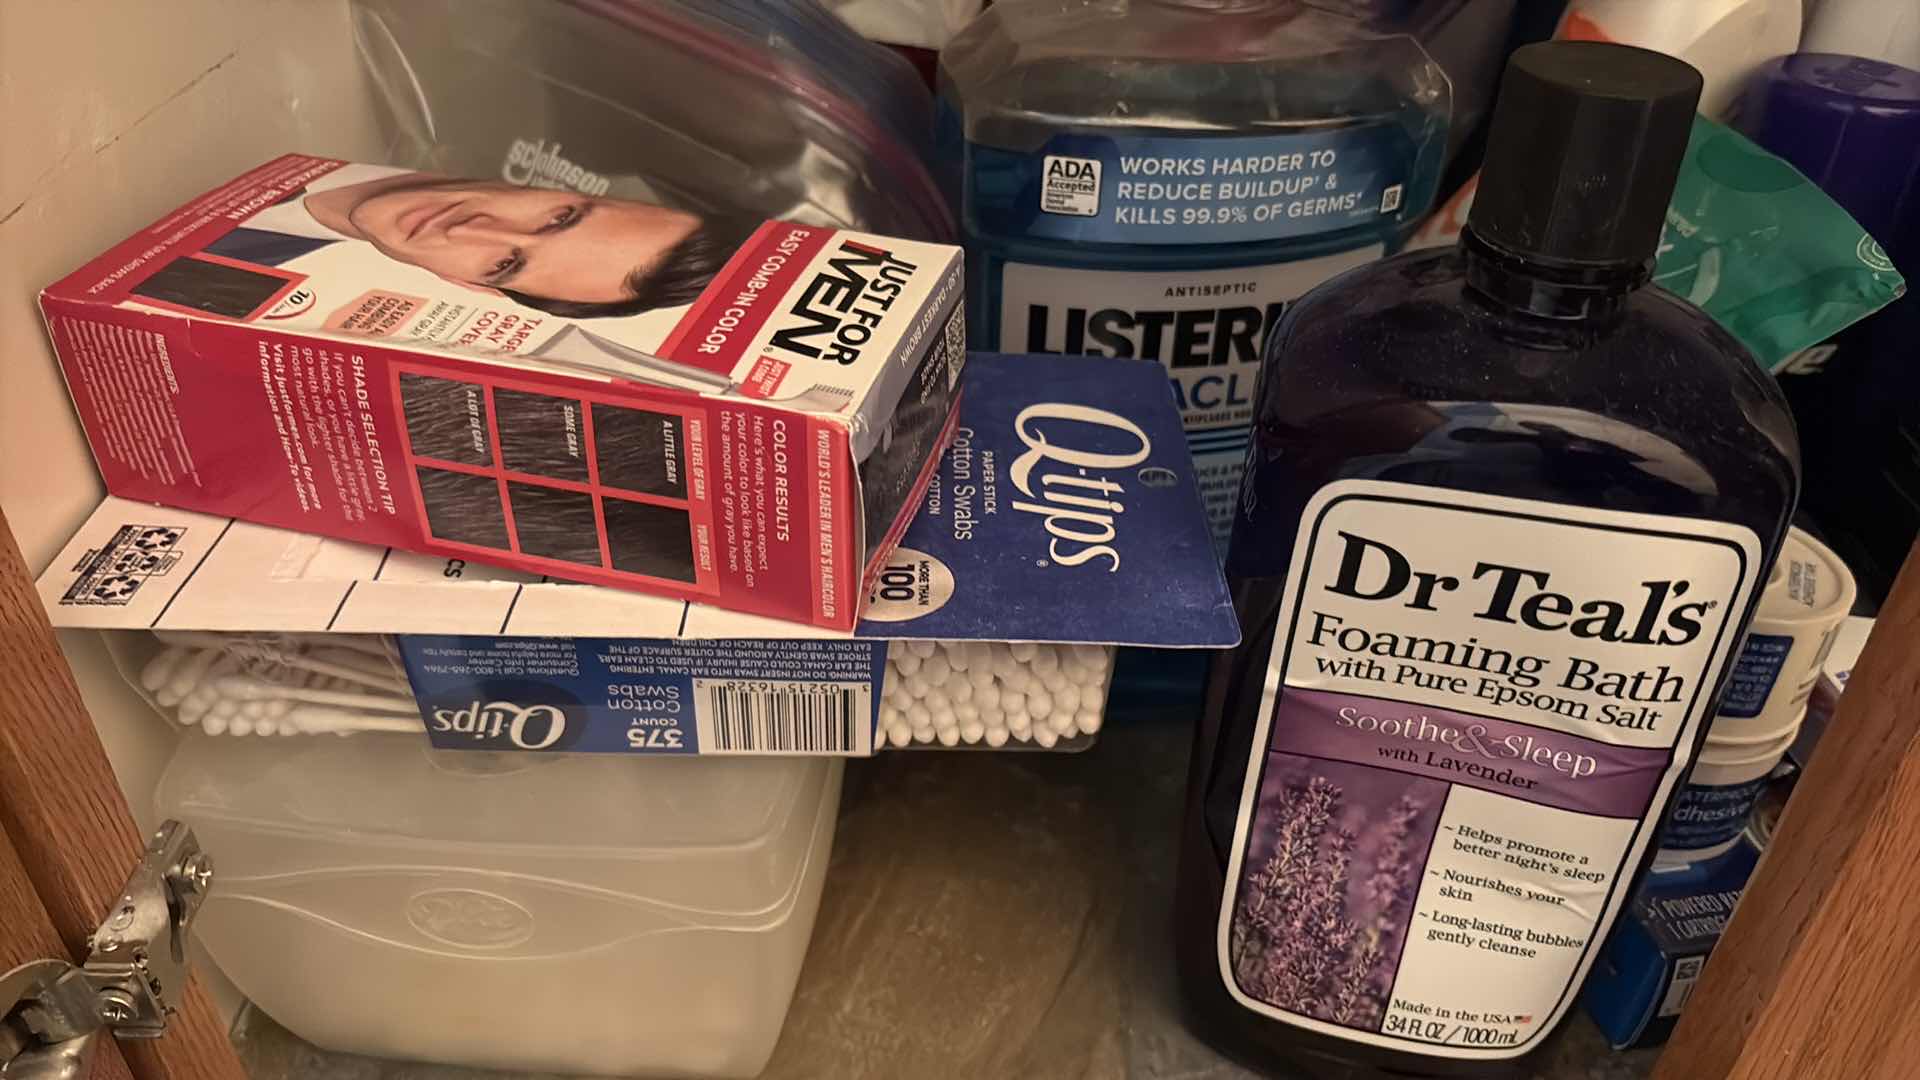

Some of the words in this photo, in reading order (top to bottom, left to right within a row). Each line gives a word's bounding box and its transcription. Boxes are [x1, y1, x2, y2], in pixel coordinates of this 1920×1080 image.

[1047, 159, 1096, 180] ADA
[1119, 156, 1206, 177] WORKS
[1212, 152, 1302, 175] HARDER
[1310, 149, 1336, 169] TO
[1046, 179, 1096, 193] Accepted
[1117, 180, 1212, 201] REDUCE
[1324, 173, 1337, 190] &
[1114, 206, 1175, 225] KILLS
[1182, 204, 1247, 225] 99.9%
[1253, 201, 1283, 221] OF
[775, 229, 811, 256] EASY
[733, 254, 787, 307] COMB-IN
[862, 252, 918, 312] JUST
[1165, 281, 1257, 298] ANTISEPTIC
[289, 290, 310, 305] 10
[769, 240, 888, 359] MEN
[486, 314, 520, 343] GRAY
[502, 319, 543, 352] TARGE
[697, 307, 746, 354] COLOR
[822, 308, 884, 366] FOR
[258, 341, 279, 412] information
[273, 414, 288, 435] and
[273, 343, 285, 373] Visit
[302, 466, 313, 482] for
[308, 483, 321, 509] more
[563, 405, 575, 431] SOME
[720, 410, 731, 431] the
[735, 412, 747, 440] your
[351, 355, 369, 409] SHADE
[361, 413, 388, 490] SELECTION
[381, 494, 395, 514] TIP
[566, 432, 578, 456] GRAY
[663, 429, 675, 458] LITTLE
[752, 415, 765, 455] Here's
[772, 419, 788, 473] COLOR
[721, 434, 733, 480] amount
[737, 442, 749, 473] color
[951, 427, 975, 480] Cotton
[982, 450, 994, 485] PAPER
[665, 459, 677, 483] GRAY
[739, 476, 748, 488] to
[754, 457, 766, 485] what
[724, 482, 735, 495] of
[754, 488, 764, 509] you
[818, 479, 831, 518] LEADER
[984, 485, 996, 515] STICK
[1010, 402, 1151, 573] Q-tips
[722, 496, 735, 522] gray
[739, 491, 751, 514] look
[773, 476, 790, 541] RESULTS
[953, 485, 976, 541] Swabs
[724, 524, 736, 543] you
[741, 518, 752, 537] like
[757, 511, 765, 531] can
[820, 519, 831, 529] IN
[743, 540, 754, 571] based
[756, 534, 768, 570] expect
[746, 573, 753, 587] on
[880, 564, 915, 602] 100
[918, 560, 929, 586] MORE
[821, 566, 834, 617] HAIRCOLOR
[918, 586, 929, 606] THAN
[1323, 531, 1459, 612] Dr
[1471, 561, 1708, 646] Teal's
[624, 655, 653, 663] CLEAN
[642, 646, 680, 654] SURFACE
[669, 657, 692, 665] USED
[683, 647, 713, 655] OUTER
[734, 650, 772, 658] AROUND
[770, 660, 800, 668] COULD
[1305, 610, 1550, 689] Foaming
[1557, 656, 1686, 704] Bath
[609, 664, 653, 672] ENTERING
[711, 667, 731, 675] INTO
[760, 669, 790, 677] INSERT
[812, 670, 825, 678] DO
[607, 685, 680, 698] Swabs
[726, 682, 776, 693] 16328
[787, 684, 840, 694] 05215
[1314, 654, 1386, 683] with
[1391, 664, 1468, 696] Pure
[1473, 678, 1589, 722] Epsom
[1595, 702, 1663, 732] Salt
[608, 701, 681, 713] Cotton
[433, 700, 567, 750] Q-tips
[631, 717, 678, 727] COUNT
[626, 728, 684, 748] 375
[1376, 743, 1419, 764] with
[1424, 751, 1538, 791] Lavender
[1457, 824, 1502, 847] Helps
[1506, 836, 1575, 864] promote
[1577, 854, 1590, 865] a
[1452, 838, 1501, 862] better
[1503, 851, 1559, 877] night's
[1562, 866, 1606, 885] sleep
[1439, 884, 1473, 903] skin
[1442, 868, 1523, 896] Nourishes
[1526, 888, 1566, 906] your
[1427, 927, 1476, 954] gently
[1478, 937, 1537, 960] cleanse
[1431, 910, 1522, 942] Long-lasting
[1525, 929, 1586, 950] bubbles
[1393, 998, 1431, 1016] Made
[1435, 1006, 1451, 1019] in
[1455, 1009, 1479, 1022] the
[1483, 1013, 1512, 1025] USA
[1386, 1014, 1407, 1034] 34
[1462, 1026, 1498, 1045] 1000
